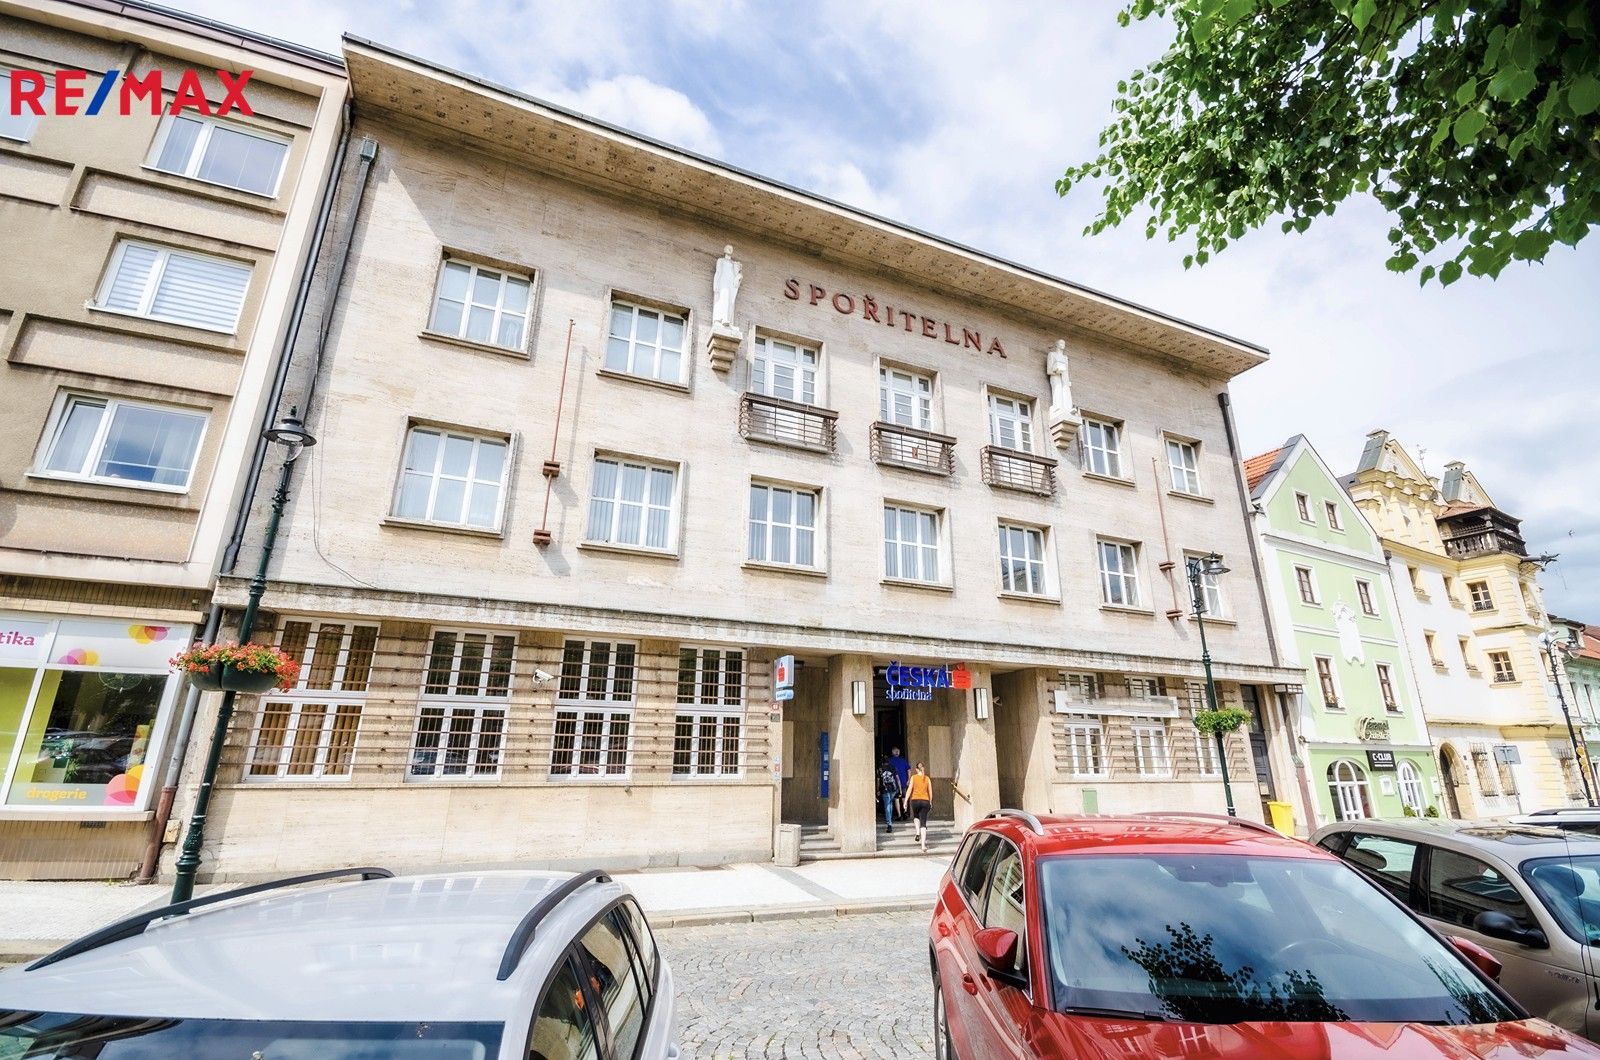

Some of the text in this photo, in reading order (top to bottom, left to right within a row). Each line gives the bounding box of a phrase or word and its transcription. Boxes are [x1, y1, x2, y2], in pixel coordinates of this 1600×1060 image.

[784, 278, 1008, 359] SPOŘITELNA
[885, 660, 950, 688] ČESKÁ
[25, 787, 88, 802] drogerie
